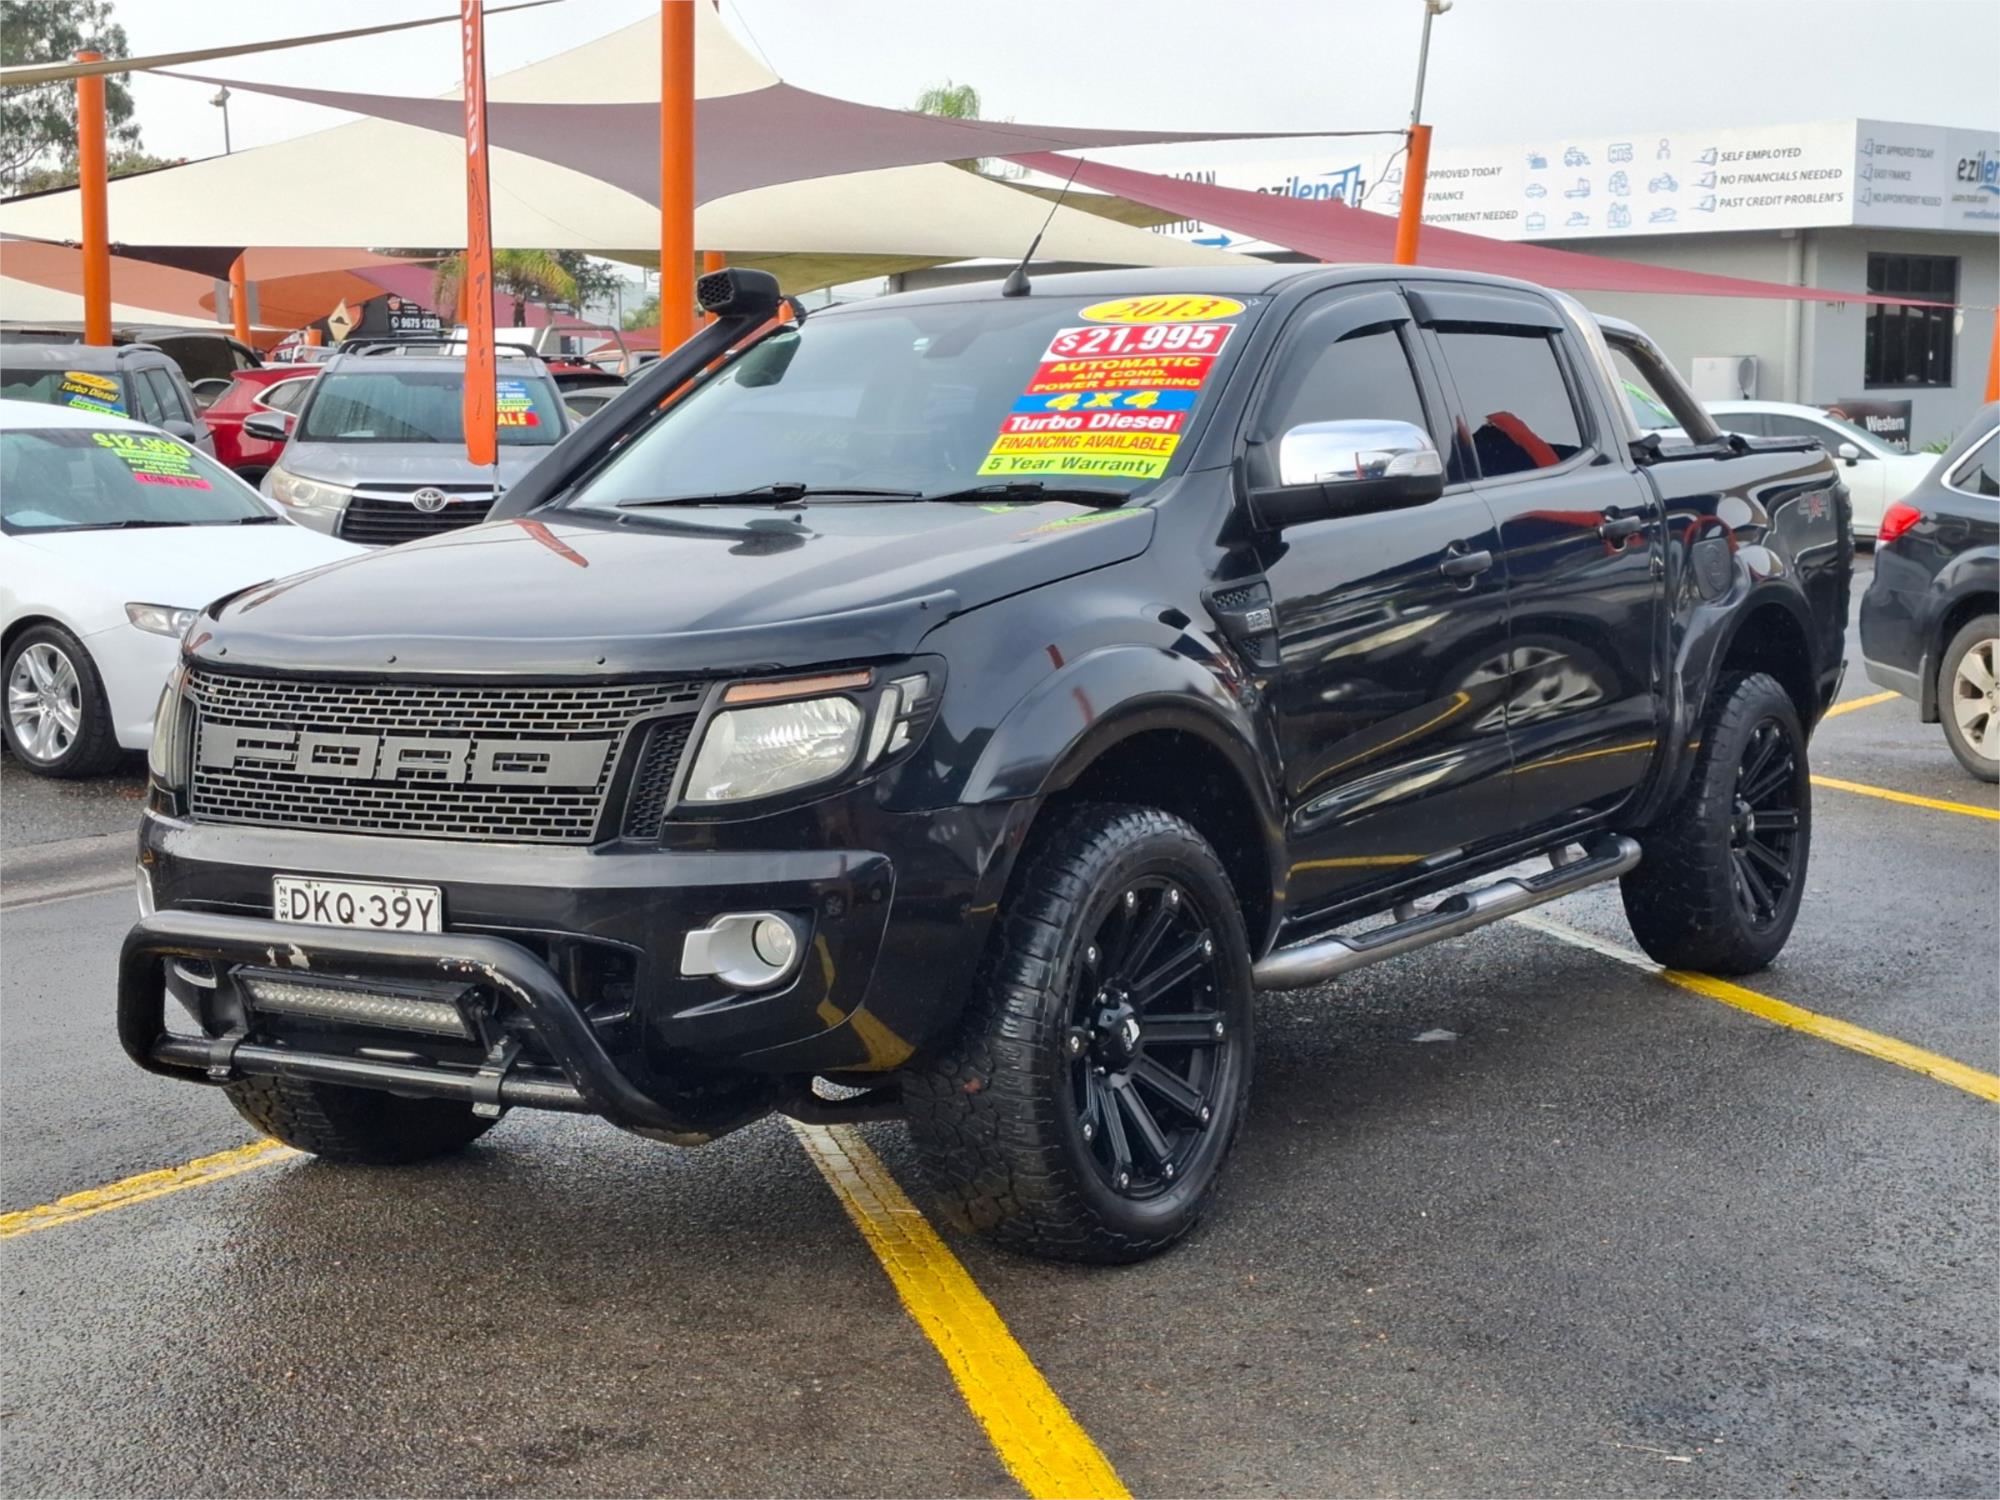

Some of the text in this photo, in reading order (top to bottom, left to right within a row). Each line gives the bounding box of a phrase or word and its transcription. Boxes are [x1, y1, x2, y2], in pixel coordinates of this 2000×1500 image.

[1720, 148, 1801, 162] SELF EMPLOYED
[1472, 167, 1502, 178] TODAY
[1720, 169, 1843, 184] NO FINANCIALS NEEDED
[1427, 191, 1464, 201] FINANCE
[1719, 192, 1844, 208] PAST CREDIT PROBLEM'S
[1483, 210, 1518, 220] NEEDED
[1104, 300, 1221, 319] 2013
[1056, 324, 1221, 354] $21,995
[1050, 356, 1203, 374] AUTOMATIC
[1073, 369, 1168, 381] AIR COND.
[1032, 378, 1200, 393] POWER STEERING
[497, 413, 527, 426] ALE
[1010, 415, 1082, 432] Turbo
[1088, 413, 1176, 430] Diesel
[1866, 416, 1905, 431] Western
[998, 435, 1172, 451] FINANCING AVAILABLE
[988, 456, 1158, 475] 5 Year Warranty
